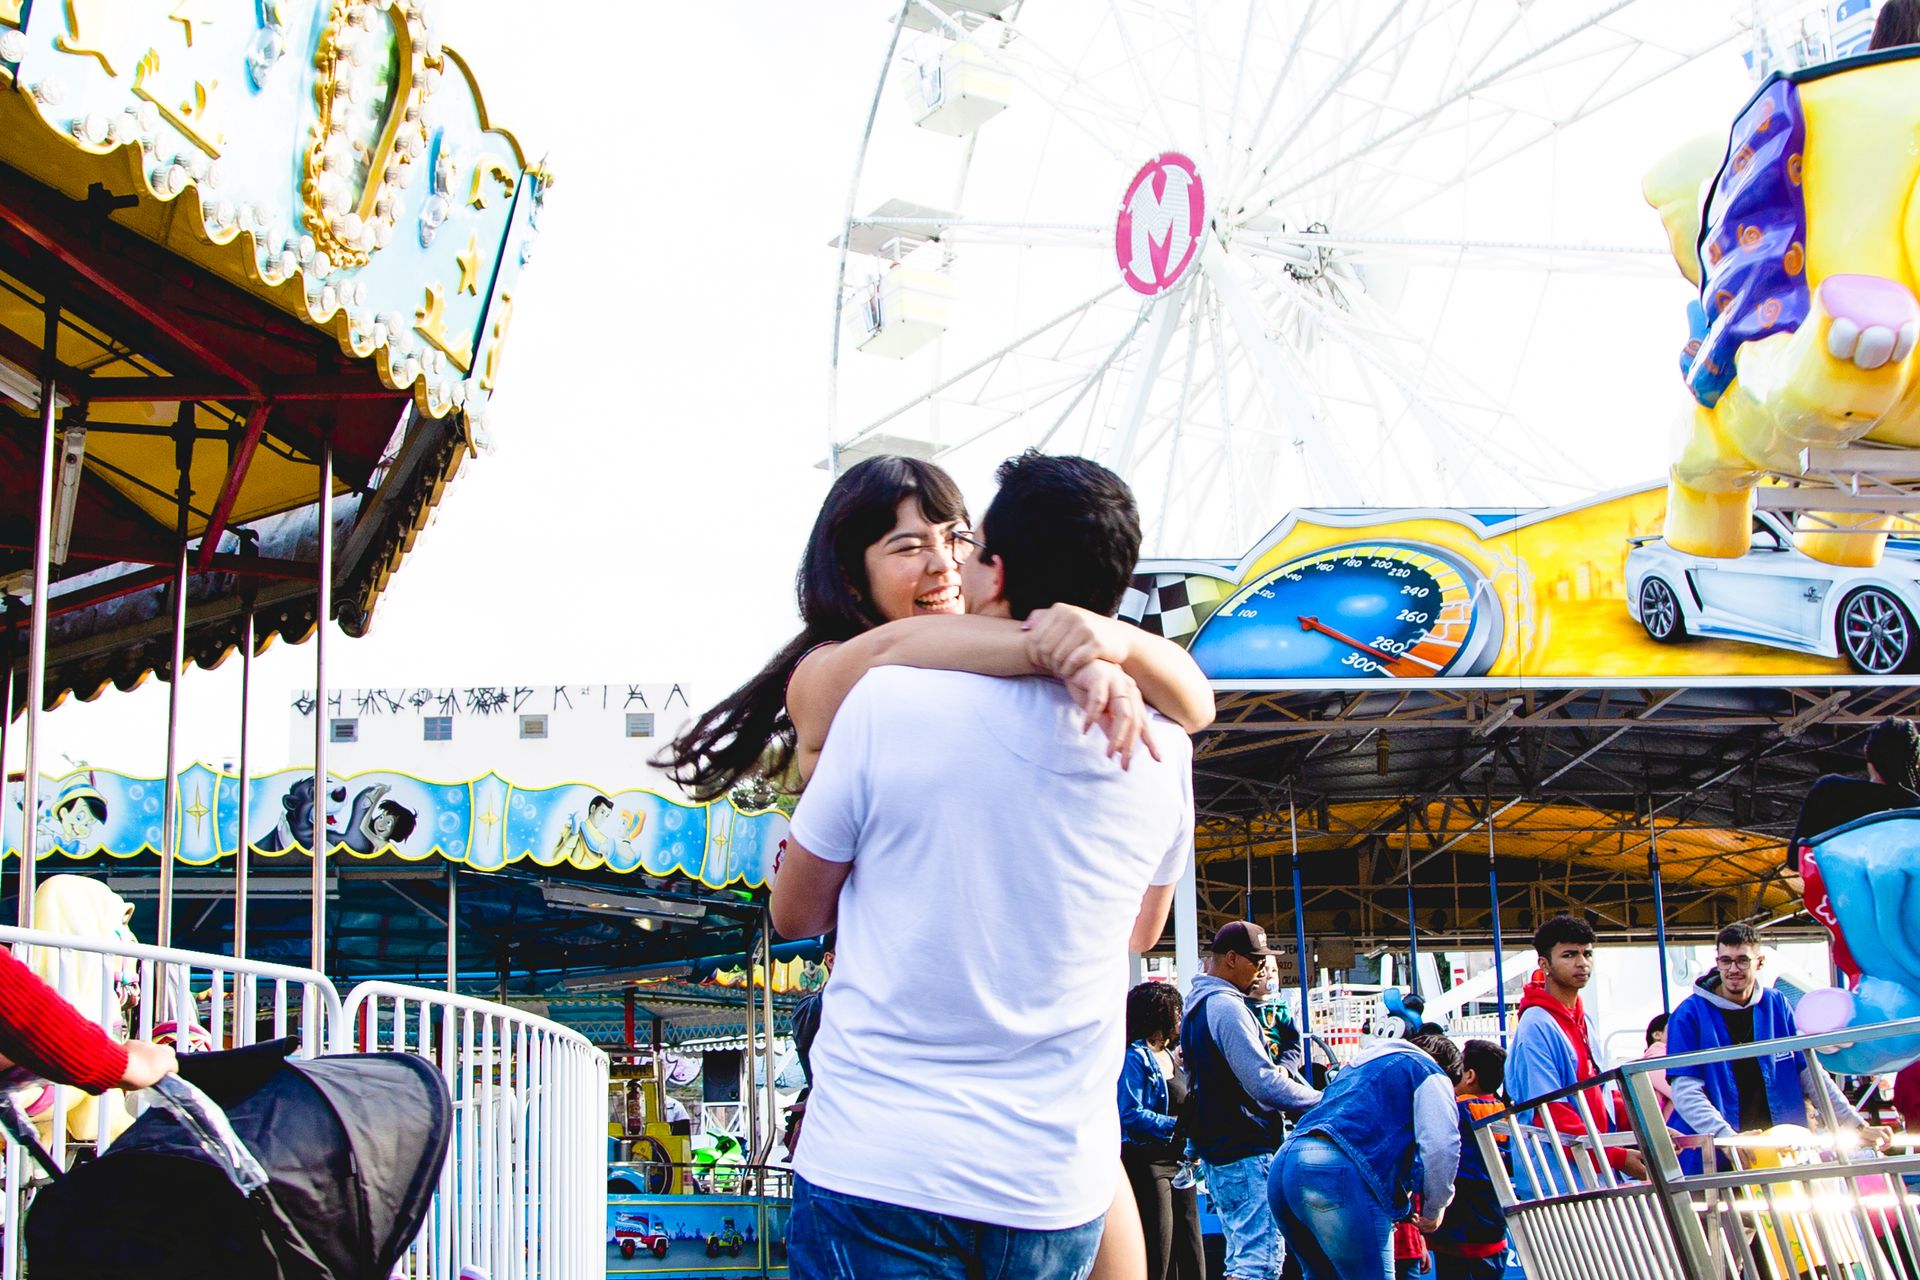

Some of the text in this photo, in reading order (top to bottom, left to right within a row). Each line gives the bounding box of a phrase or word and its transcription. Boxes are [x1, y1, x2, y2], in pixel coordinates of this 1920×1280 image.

[1127, 164, 1194, 285] M
[1316, 563, 1334, 571] 160
[1342, 559, 1362, 567] 180
[1371, 560, 1393, 569] 200
[1388, 568, 1411, 578] 220
[1259, 589, 1276, 599] 120
[1400, 585, 1430, 598] 240
[1237, 609, 1258, 618] 100
[1396, 609, 1428, 624] 260
[1369, 636, 1405, 653] 280
[1341, 652, 1377, 672] 300
[1284, 943, 1309, 954] TEMO
